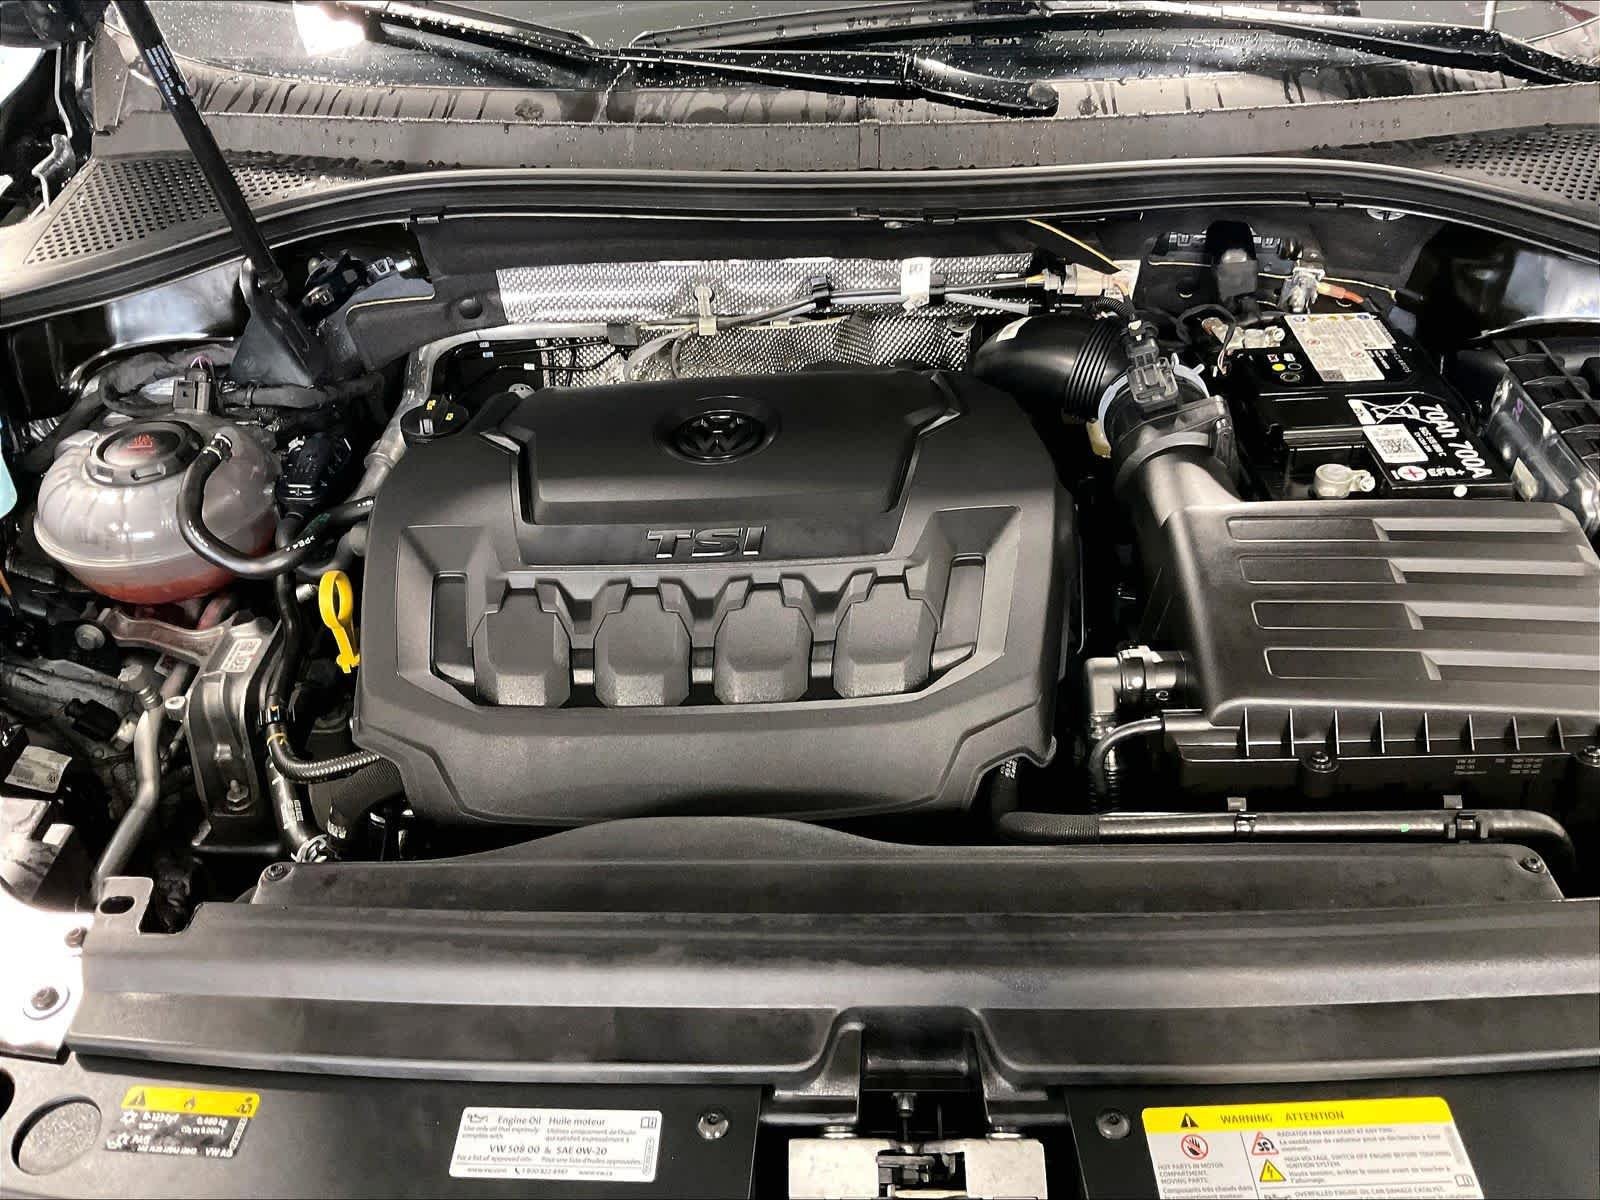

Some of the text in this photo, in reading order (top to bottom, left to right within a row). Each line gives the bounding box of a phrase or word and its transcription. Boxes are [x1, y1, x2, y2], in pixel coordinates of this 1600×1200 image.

[1420, 403, 1460, 438] 70Ah
[1447, 440, 1493, 479] 700A
[647, 525, 767, 559] TSI
[498, 1114, 542, 1127] Engine Oil
[548, 1115, 606, 1126] Huile moteur
[1220, 1110, 1345, 1124] WARNING ATTENTION
[489, 1144, 507, 1153] VW
[508, 1144, 526, 1153] 508
[527, 1145, 541, 1154] 00
[557, 1146, 574, 1155] SAE
[575, 1146, 608, 1156] 0W-20
